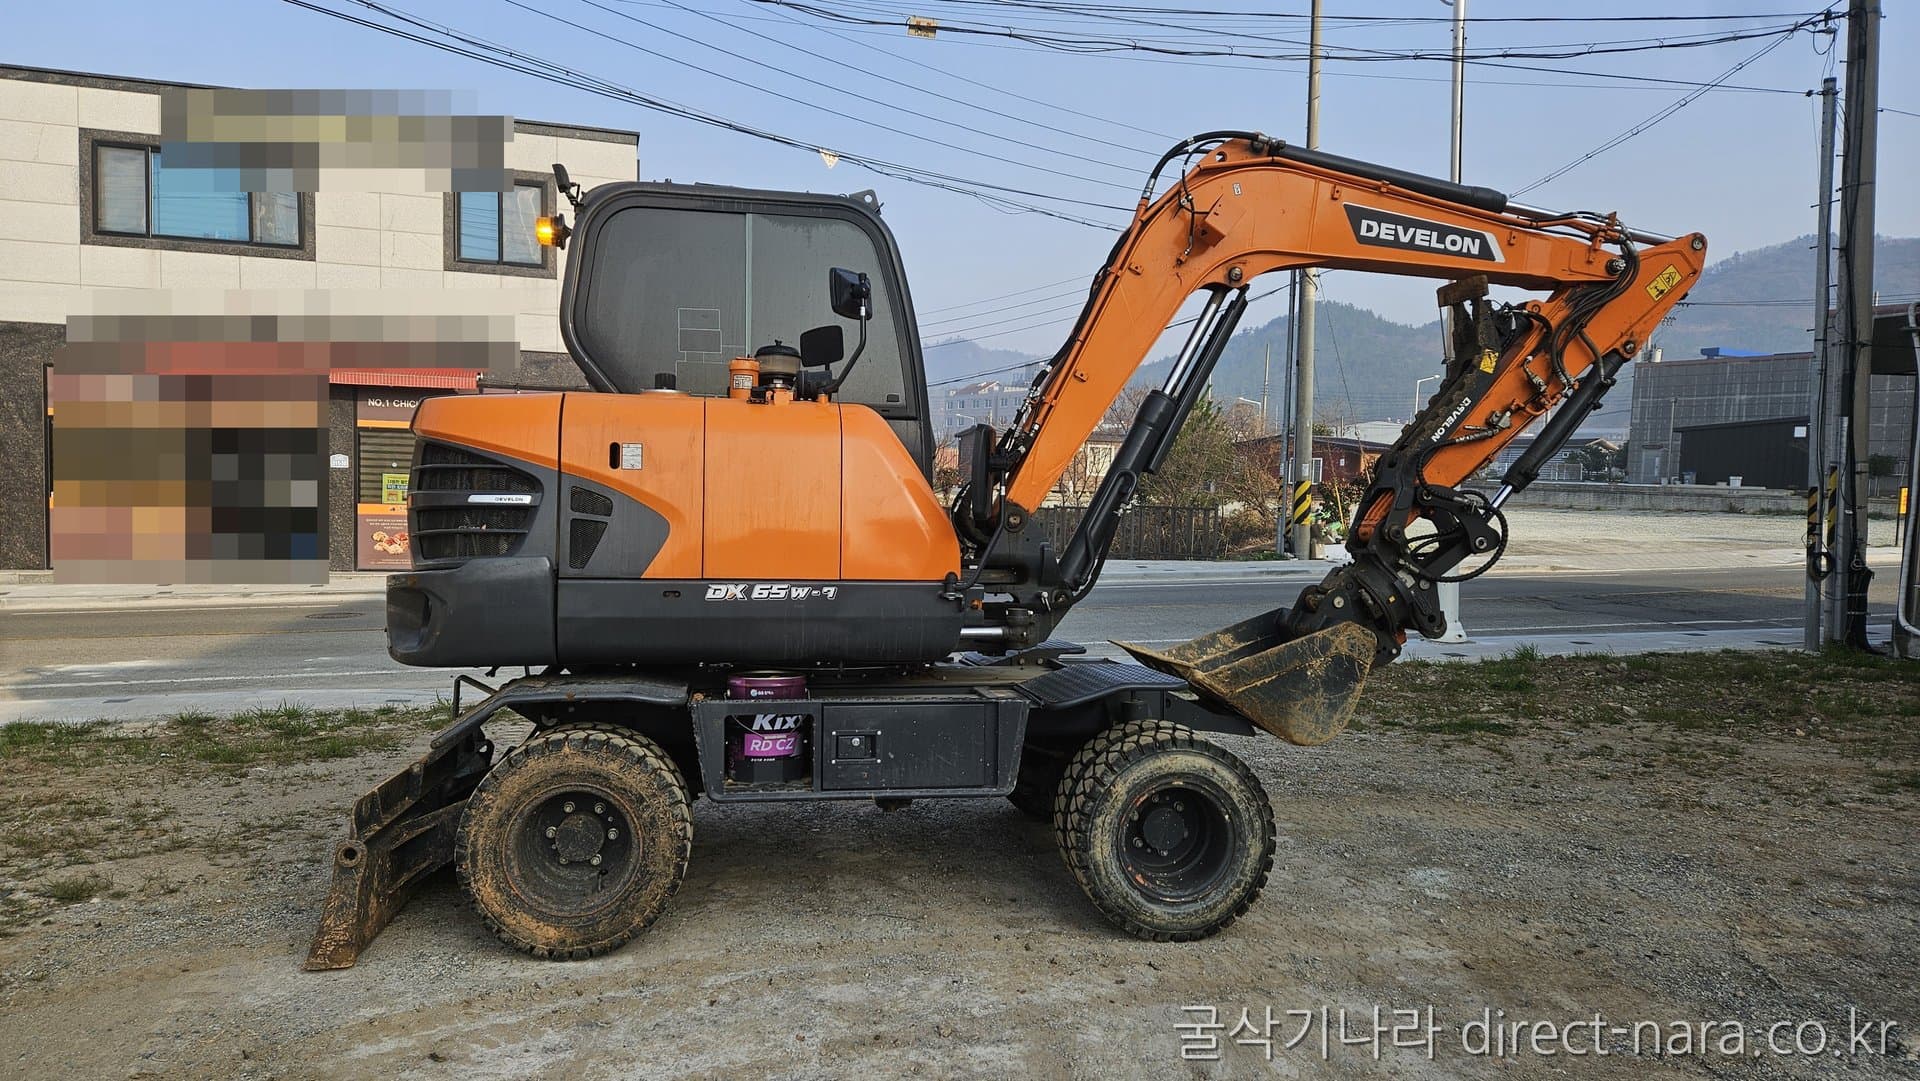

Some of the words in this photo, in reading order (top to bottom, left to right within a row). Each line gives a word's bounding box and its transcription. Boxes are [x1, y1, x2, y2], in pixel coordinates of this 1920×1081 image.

[1359, 219, 1481, 256] DEVELON
[367, 398, 390, 408] NO.1
[392, 399, 420, 409] CHIC
[1431, 396, 1472, 443] DEVELON
[705, 583, 748, 601] DX
[750, 738, 773, 752] RD
[775, 737, 795, 750] CZ
